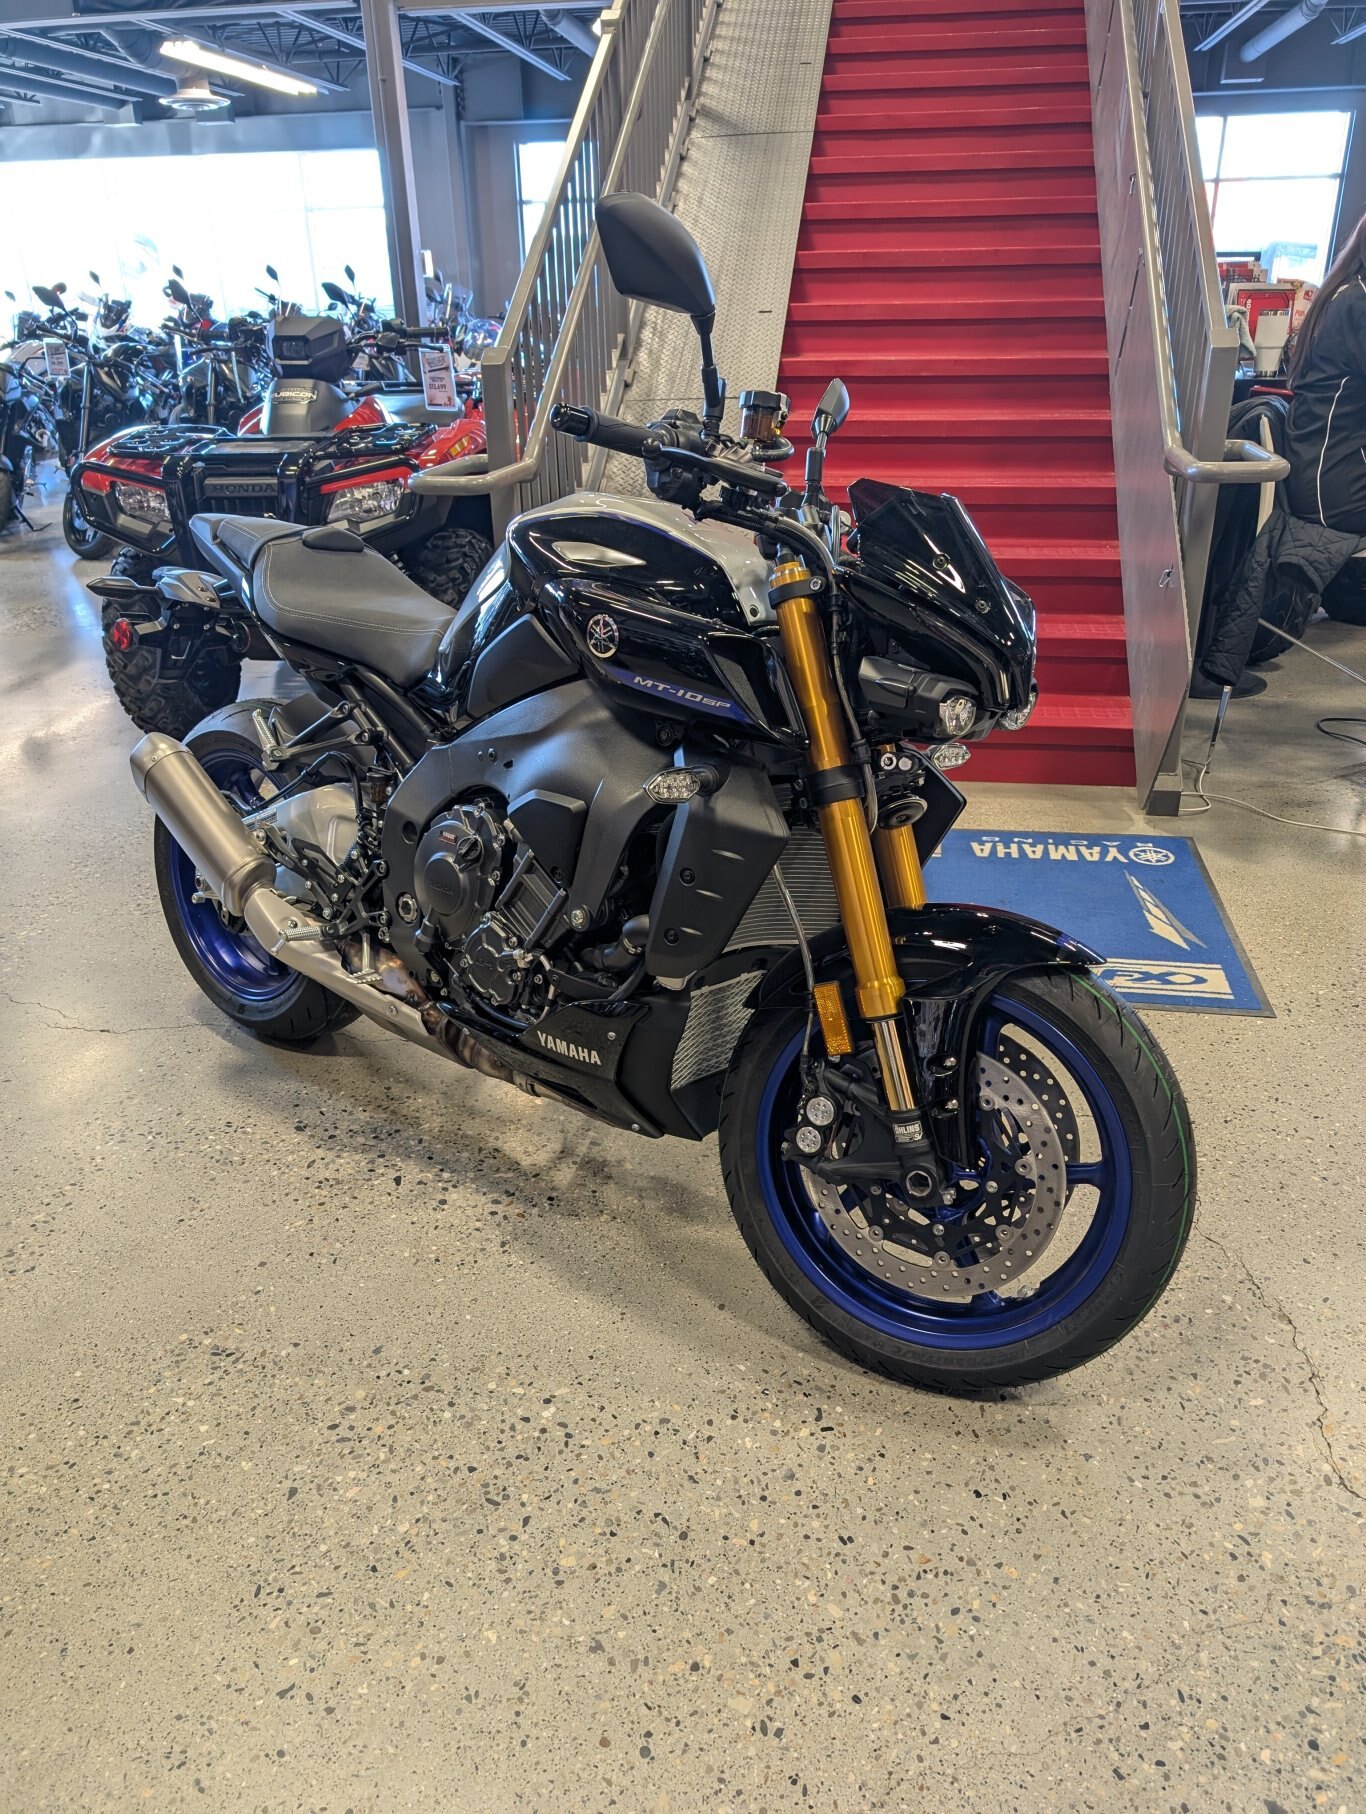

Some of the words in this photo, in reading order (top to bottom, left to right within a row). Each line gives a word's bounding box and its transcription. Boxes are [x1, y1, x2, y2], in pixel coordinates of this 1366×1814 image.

[212, 484, 278, 493] HONDA
[970, 841, 1129, 862] YAMAHA
[536, 1030, 602, 1066] YAMAHA
